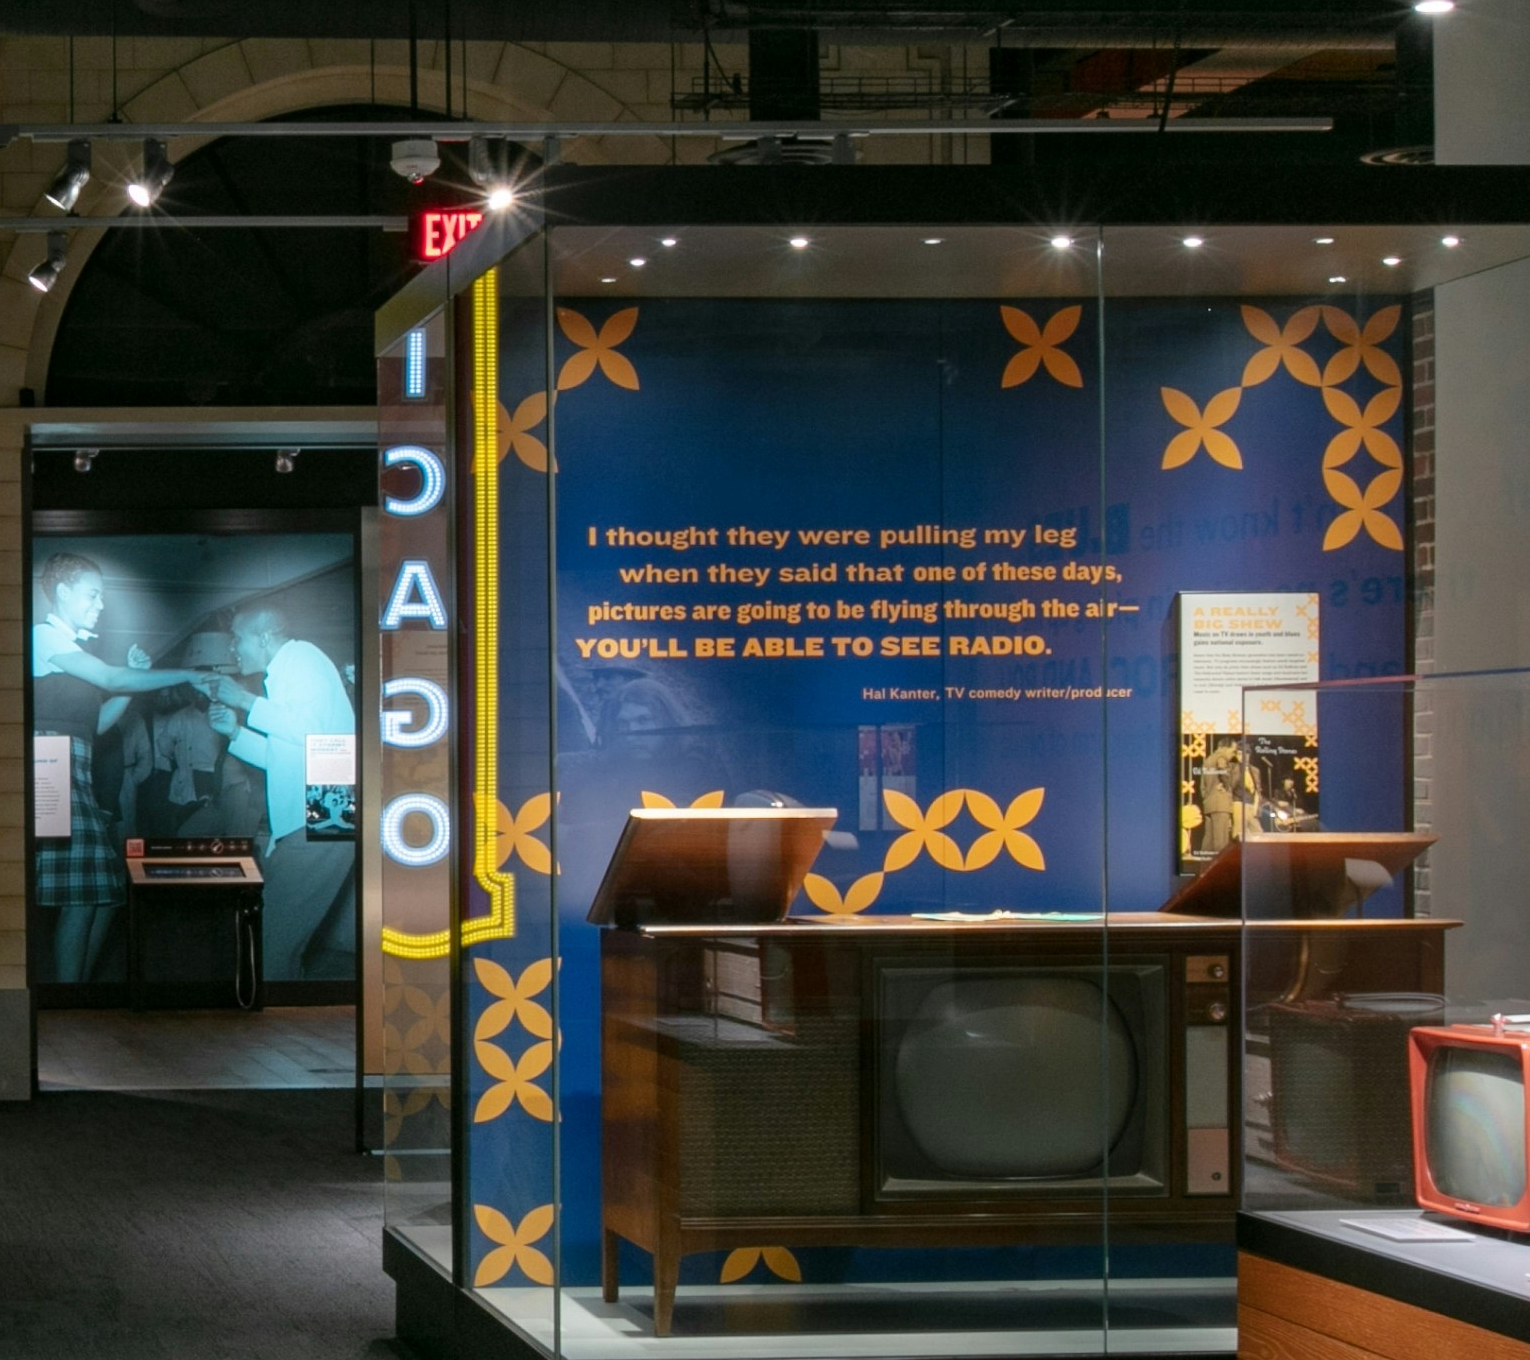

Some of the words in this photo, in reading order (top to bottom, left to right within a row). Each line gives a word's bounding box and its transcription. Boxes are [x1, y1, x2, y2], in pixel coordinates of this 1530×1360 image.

[425, 214, 483, 256] EXIT
[589, 527, 596, 546] I
[606, 527, 718, 550] thought
[727, 527, 790, 549] they
[798, 531, 870, 545] were
[881, 525, 976, 548] pulling
[985, 530, 1026, 547] my
[1036, 525, 1076, 548] leg
[620, 564, 698, 583] when
[708, 564, 770, 586] they
[780, 563, 837, 582] said
[846, 563, 904, 581] that
[914, 567, 956, 581] one
[962, 562, 986, 581] of
[992, 562, 1056, 580] these
[1062, 562, 1122, 584] days,
[588, 602, 686, 625] pictures
[692, 605, 731, 620] are
[737, 601, 801, 624] going
[806, 602, 830, 619] to
[837, 600, 864, 619] be
[870, 600, 938, 623] flying
[944, 599, 1035, 622] through
[1042, 599, 1079, 617] the
[1194, 607, 1205, 616] A
[1210, 607, 1279, 616] REALLY
[1194, 620, 1223, 630] BIG
[1229, 620, 1283, 630] SHEW
[576, 639, 687, 658] YOU'LL
[695, 638, 735, 657] BE
[742, 637, 824, 657] ABLE
[832, 637, 873, 656] TO
[880, 637, 940, 656] SEE
[950, 635, 1051, 655] RADIO.
[863, 688, 886, 699] Hal
[890, 688, 940, 700] Kanter,
[945, 687, 965, 699] TV
[969, 687, 1021, 700] comedy
